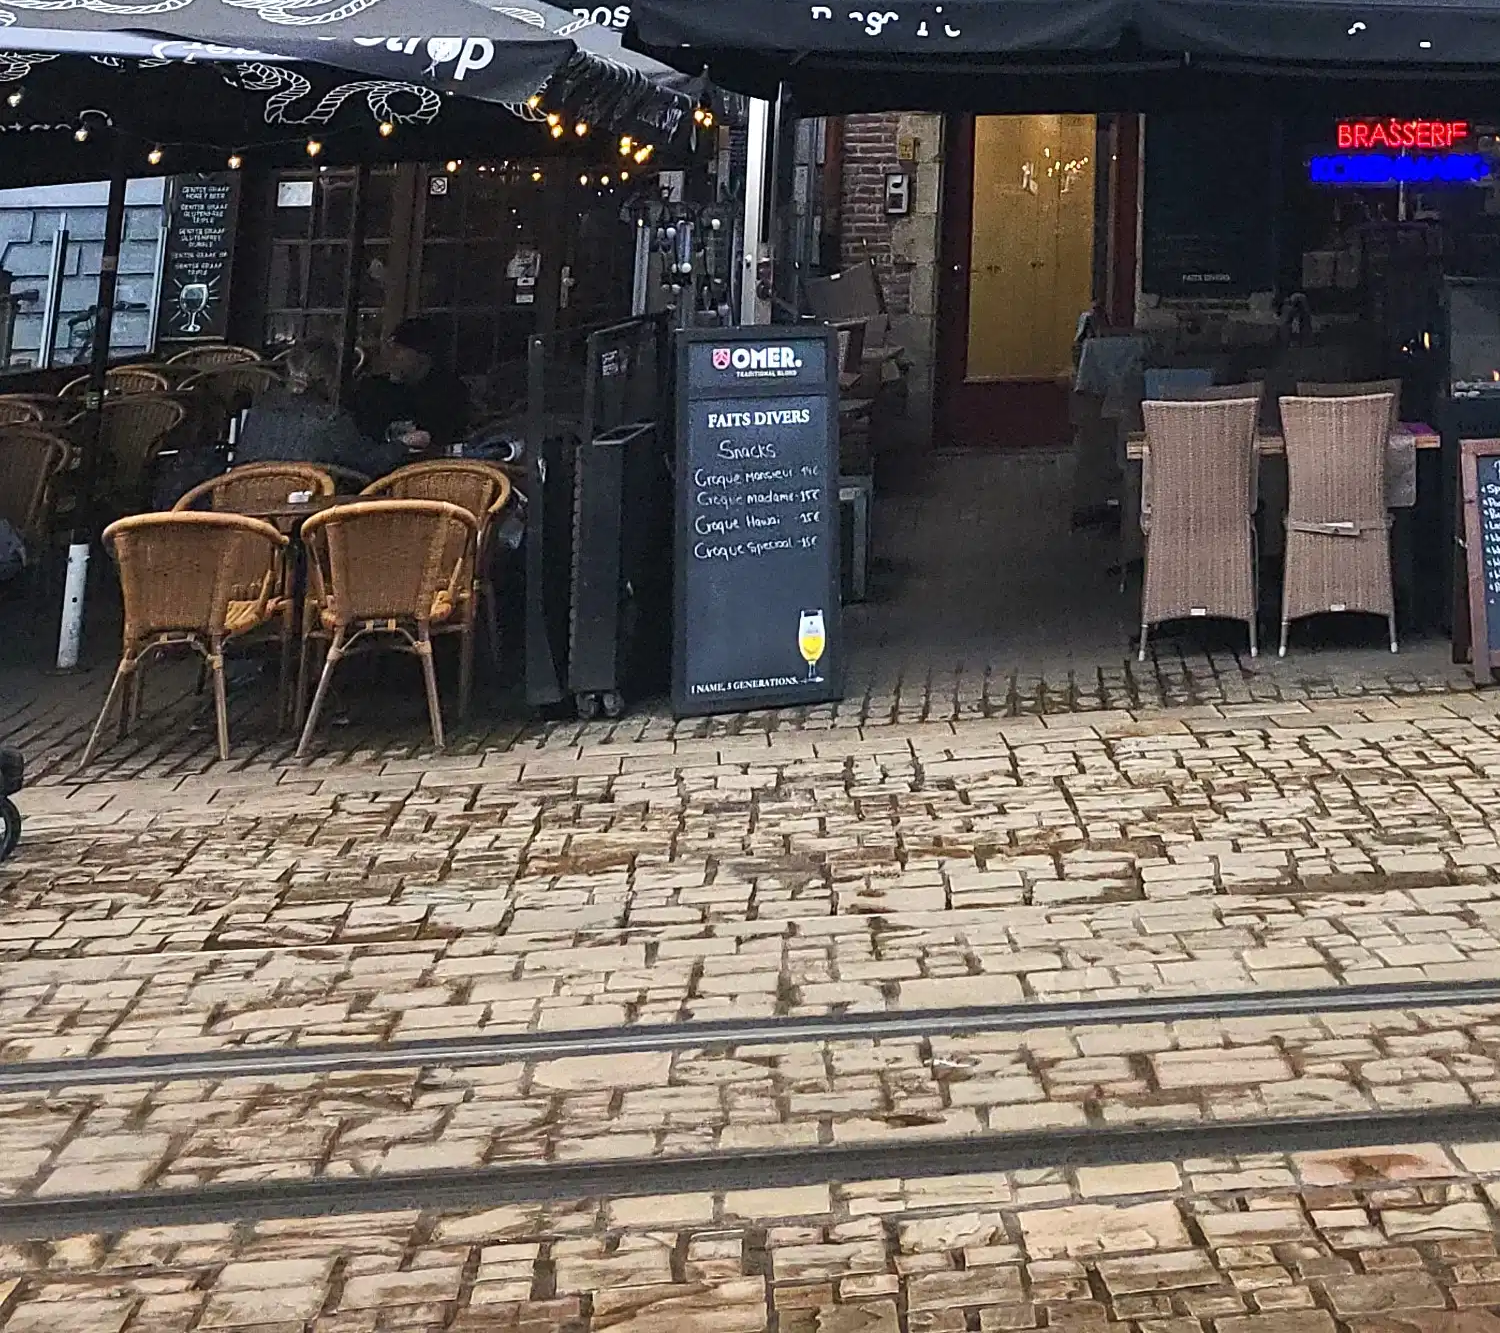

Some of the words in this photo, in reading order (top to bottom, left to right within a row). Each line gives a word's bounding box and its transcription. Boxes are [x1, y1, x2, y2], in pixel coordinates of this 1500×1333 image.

[1337, 120, 1468, 149] BRASSERIE
[731, 347, 803, 369] OMER.
[708, 413, 752, 428] FAITS
[754, 409, 810, 425] DIVERS
[717, 439, 776, 460] Snacks
[695, 468, 741, 490] Croque
[697, 491, 742, 510] Croque
[695, 515, 740, 535] Croque
[694, 542, 745, 562] Croque
